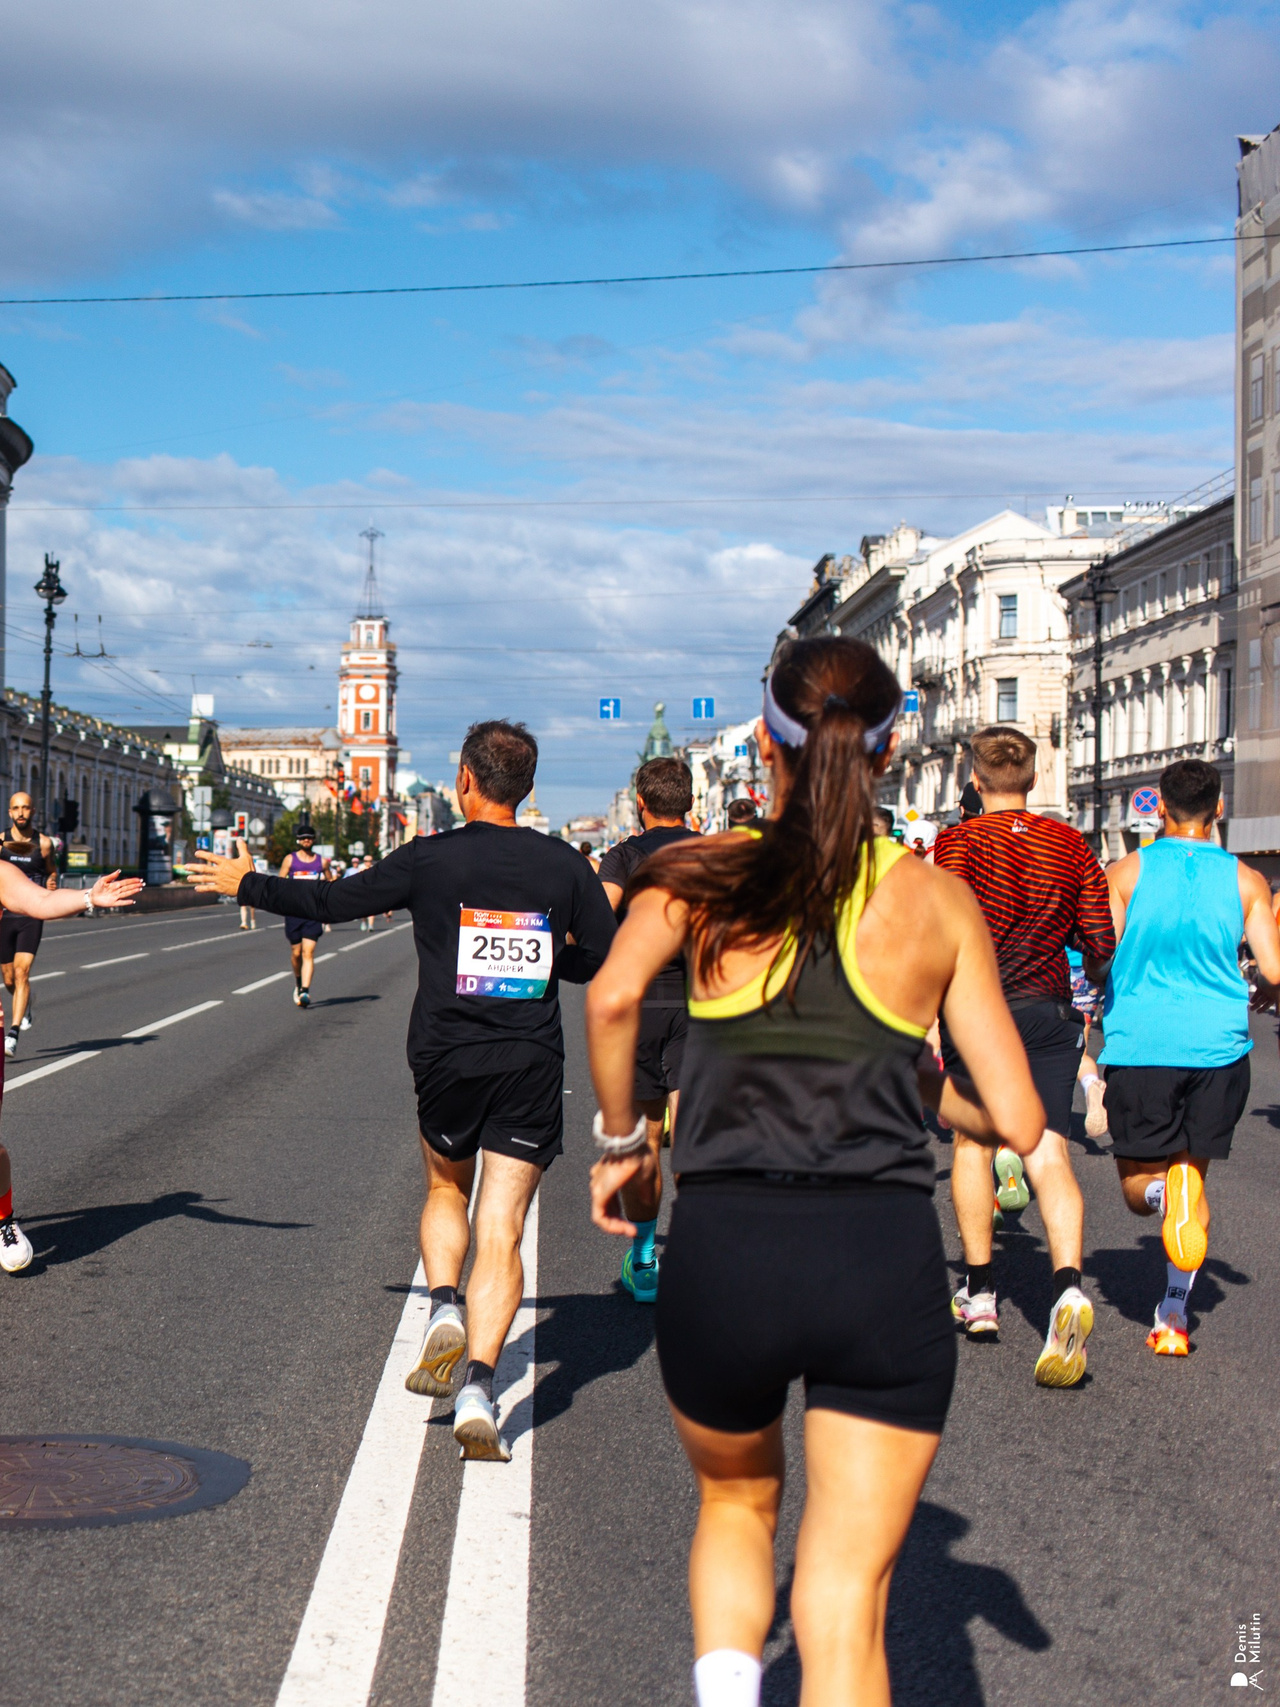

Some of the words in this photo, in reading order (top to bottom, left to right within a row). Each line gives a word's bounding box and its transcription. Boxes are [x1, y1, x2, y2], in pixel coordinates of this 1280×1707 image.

[472, 935, 541, 963] 2553
[487, 964, 524, 973] АНДРЕЙ
[466, 976, 478, 992] D
